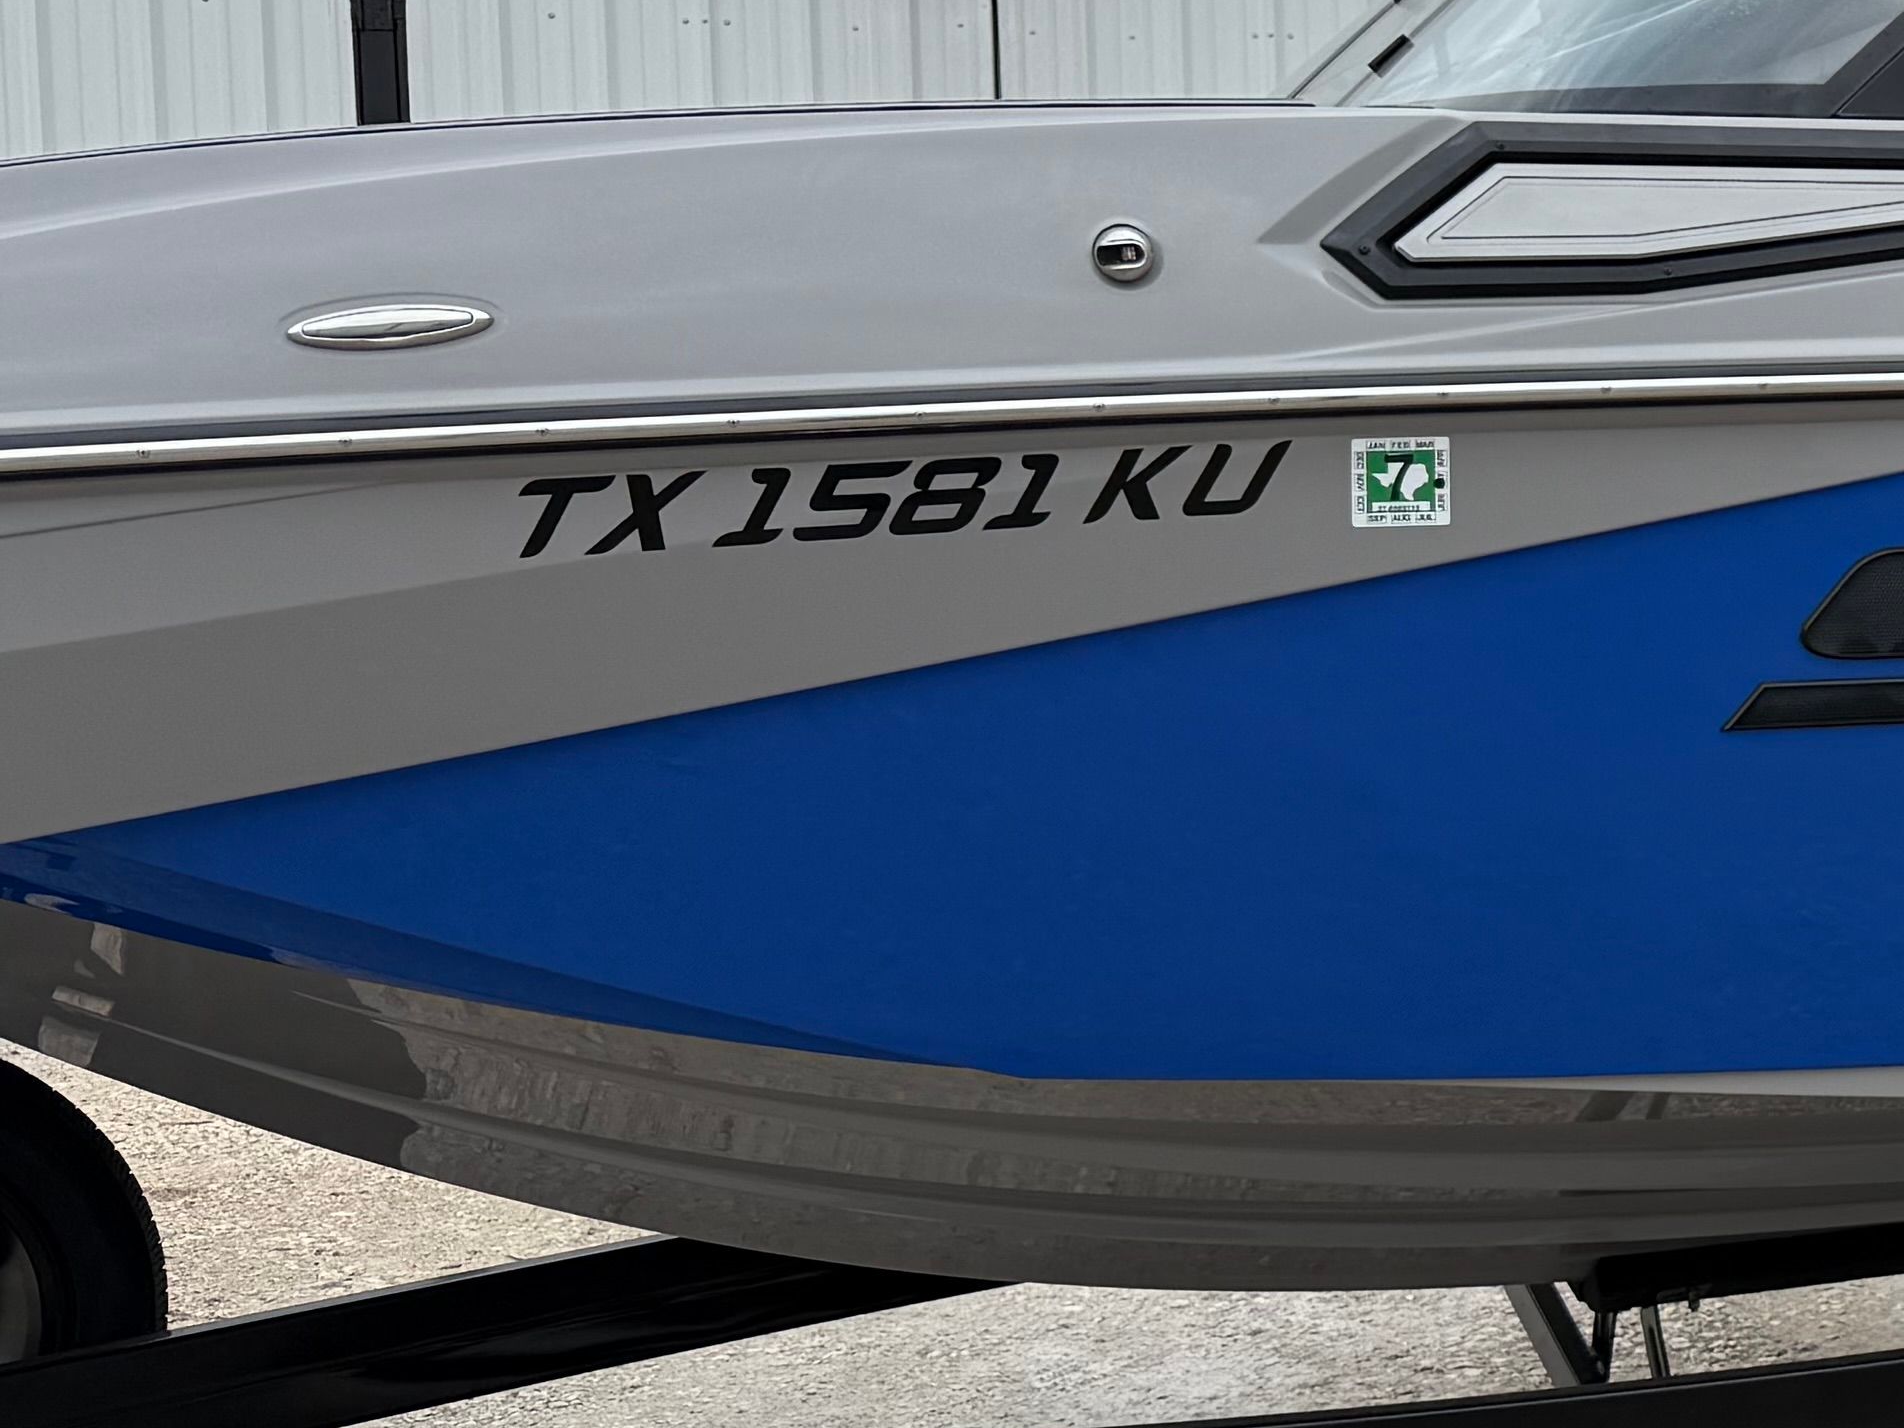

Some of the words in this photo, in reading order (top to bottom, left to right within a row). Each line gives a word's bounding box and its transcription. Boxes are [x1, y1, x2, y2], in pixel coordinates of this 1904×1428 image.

[518, 470, 709, 559] TX
[712, 453, 1060, 547] 1581
[1082, 439, 1293, 524] KU
[1384, 453, 1413, 502] 7
